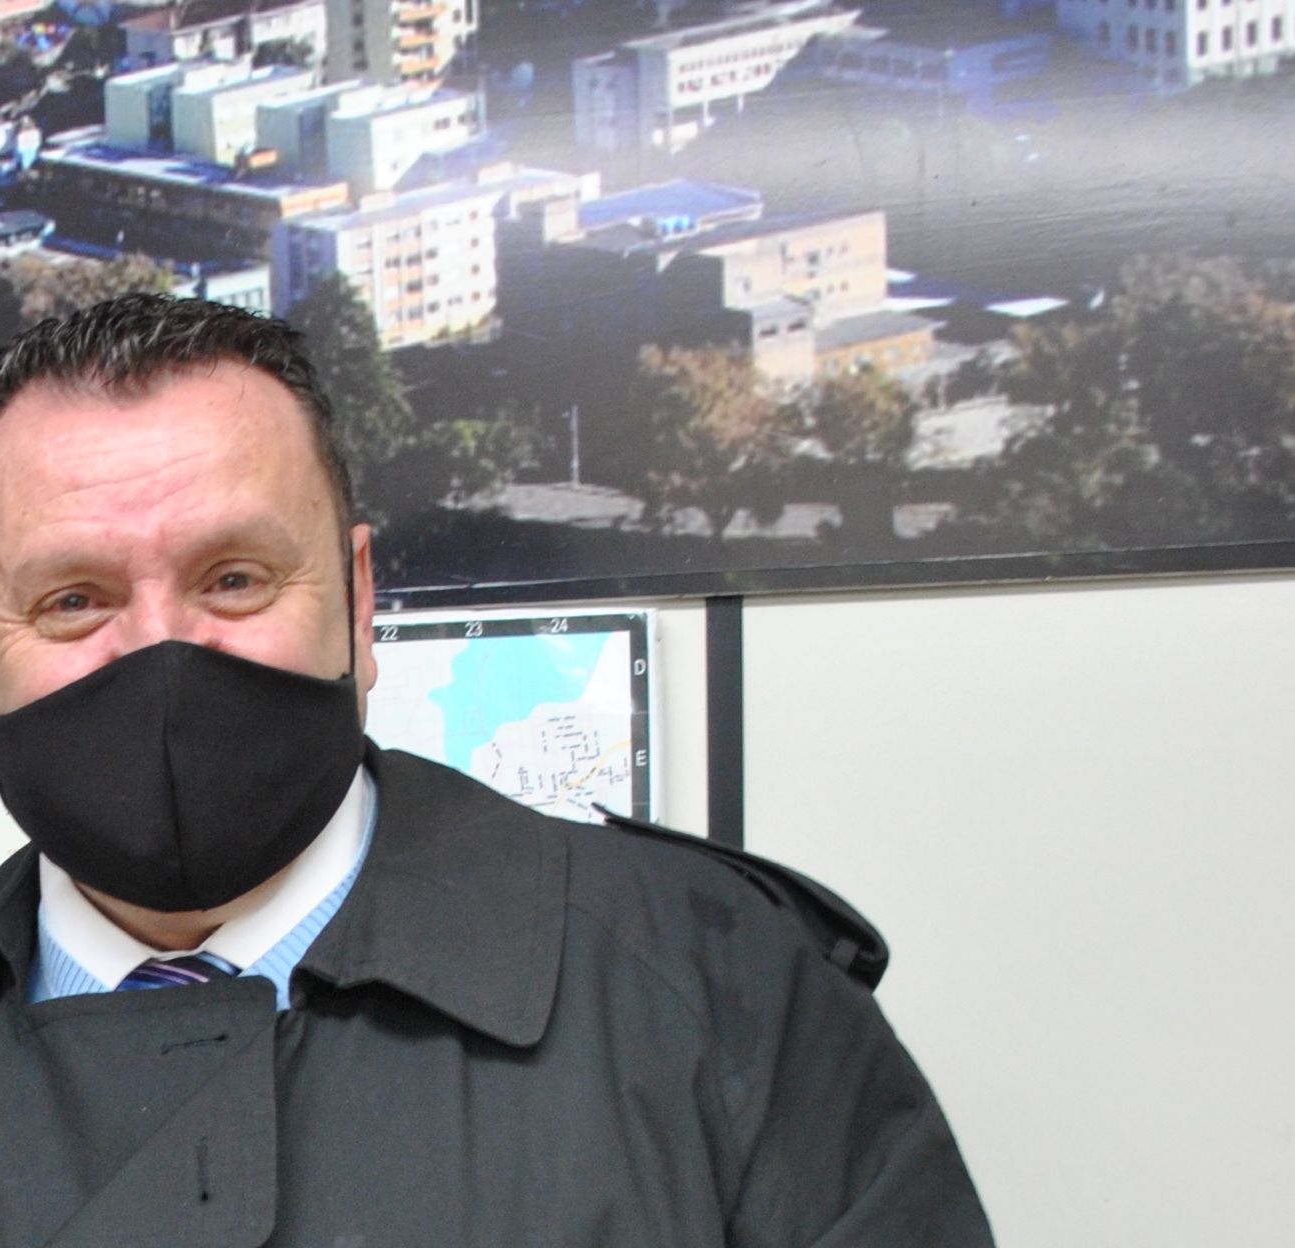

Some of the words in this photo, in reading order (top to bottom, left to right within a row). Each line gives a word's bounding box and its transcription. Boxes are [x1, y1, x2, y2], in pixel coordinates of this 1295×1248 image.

[380, 626, 399, 641] 22
[465, 621, 484, 637] 23
[550, 617, 569, 634] 24
[633, 659, 647, 676] D
[634, 749, 647, 767] E
